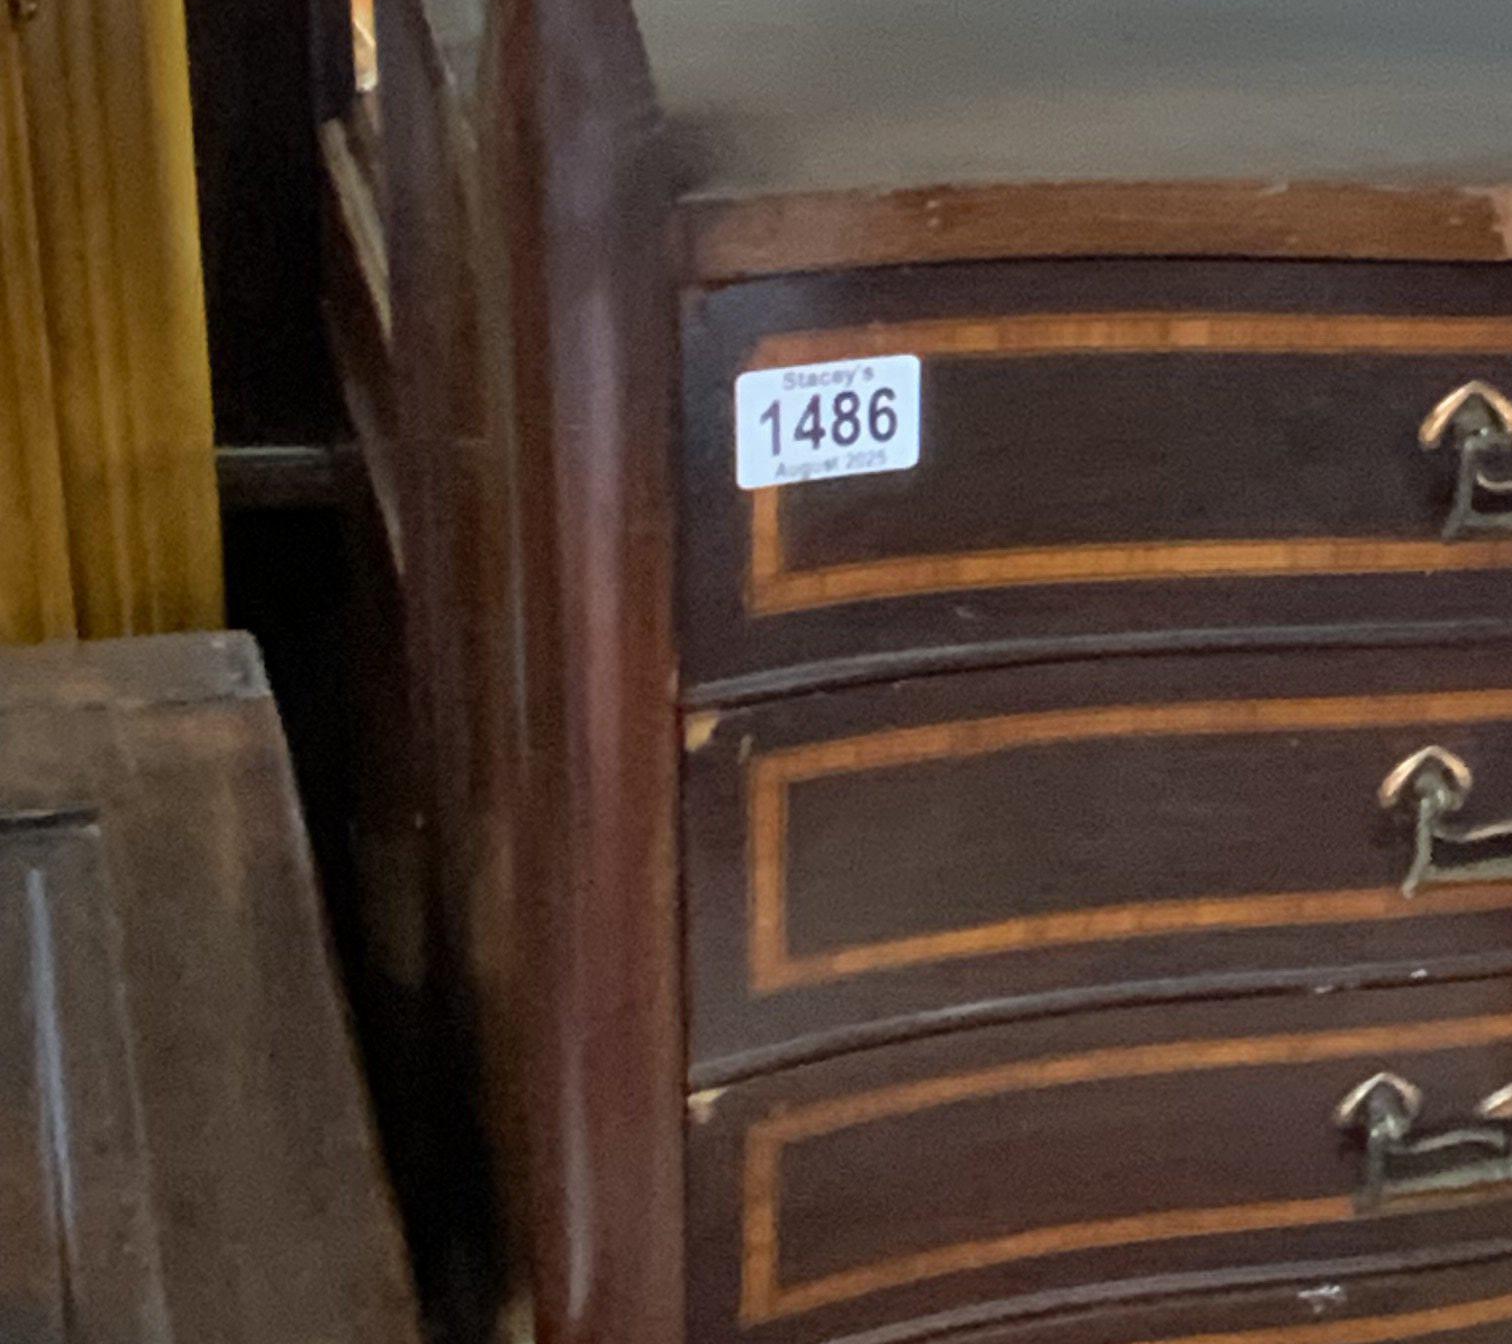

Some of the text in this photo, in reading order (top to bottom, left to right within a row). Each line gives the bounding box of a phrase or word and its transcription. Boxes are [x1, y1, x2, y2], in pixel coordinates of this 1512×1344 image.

[783, 365, 875, 390] Stacey's
[759, 387, 898, 457] 1486
[775, 457, 839, 480] August
